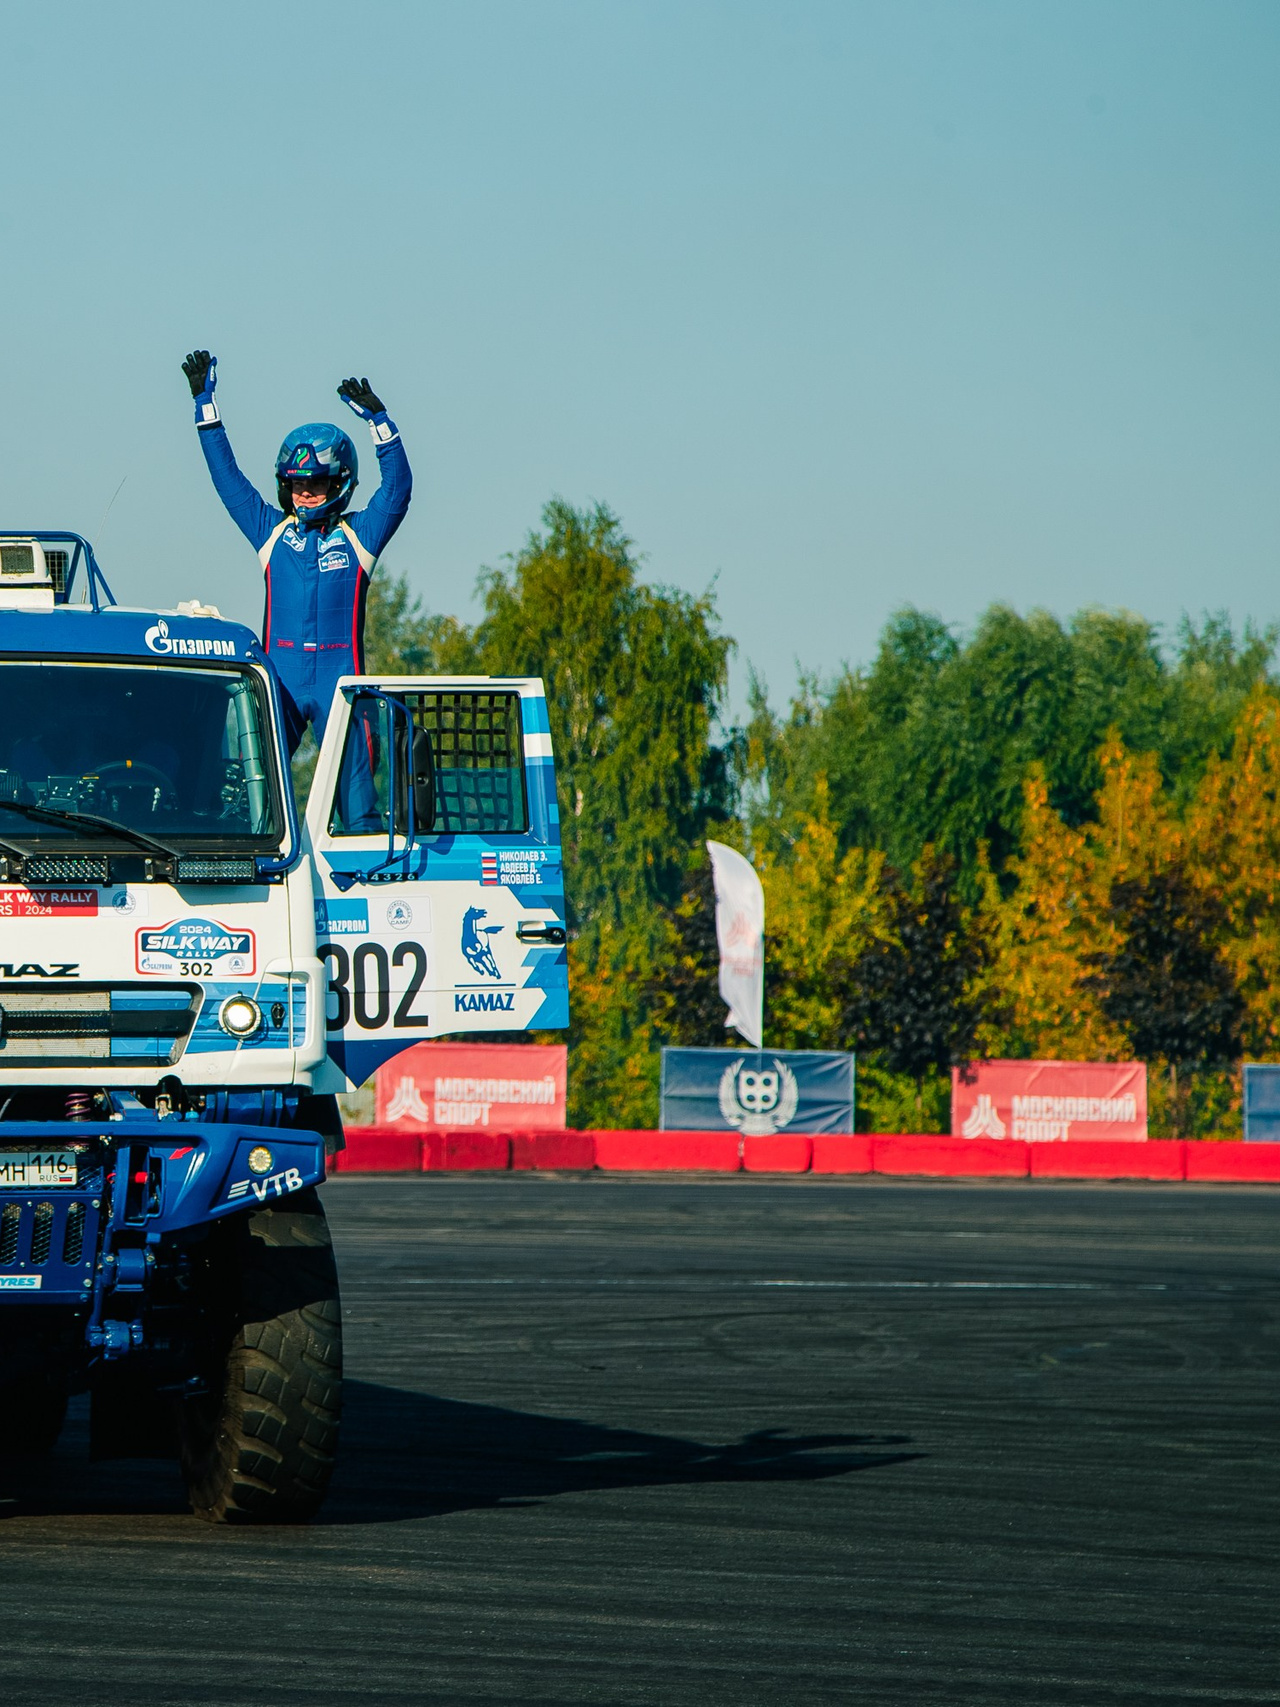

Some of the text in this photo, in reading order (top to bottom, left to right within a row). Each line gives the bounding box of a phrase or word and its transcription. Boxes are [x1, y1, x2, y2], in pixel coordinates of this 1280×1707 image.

[172, 639, 236, 656] ГАЗПРОМ
[499, 850, 548, 862] НИКОЛАЕВ Э.
[500, 862, 538, 874] АВДЕЕВ Д.
[500, 873, 535, 884] ЯКОВЛЕВ
[17, 891, 48, 903] WAY
[51, 892, 92, 903] RALLY
[25, 906, 52, 915] 2024
[179, 925, 212, 934] 2024
[327, 919, 367, 933] GAZPROM
[145, 935, 246, 951] SILK WAY
[180, 962, 213, 976] 302
[317, 940, 429, 1032] 302
[454, 993, 515, 1013] KAMAZ
[434, 1075, 556, 1104] МОСКОВСКИЙ
[434, 1102, 492, 1126] СПОРТ
[1012, 1092, 1137, 1122] МОСКОВСКИЙ
[1011, 1120, 1071, 1142] СПОРТ
[31, 1154, 69, 1174] 116
[251, 1167, 304, 1201] VTB
